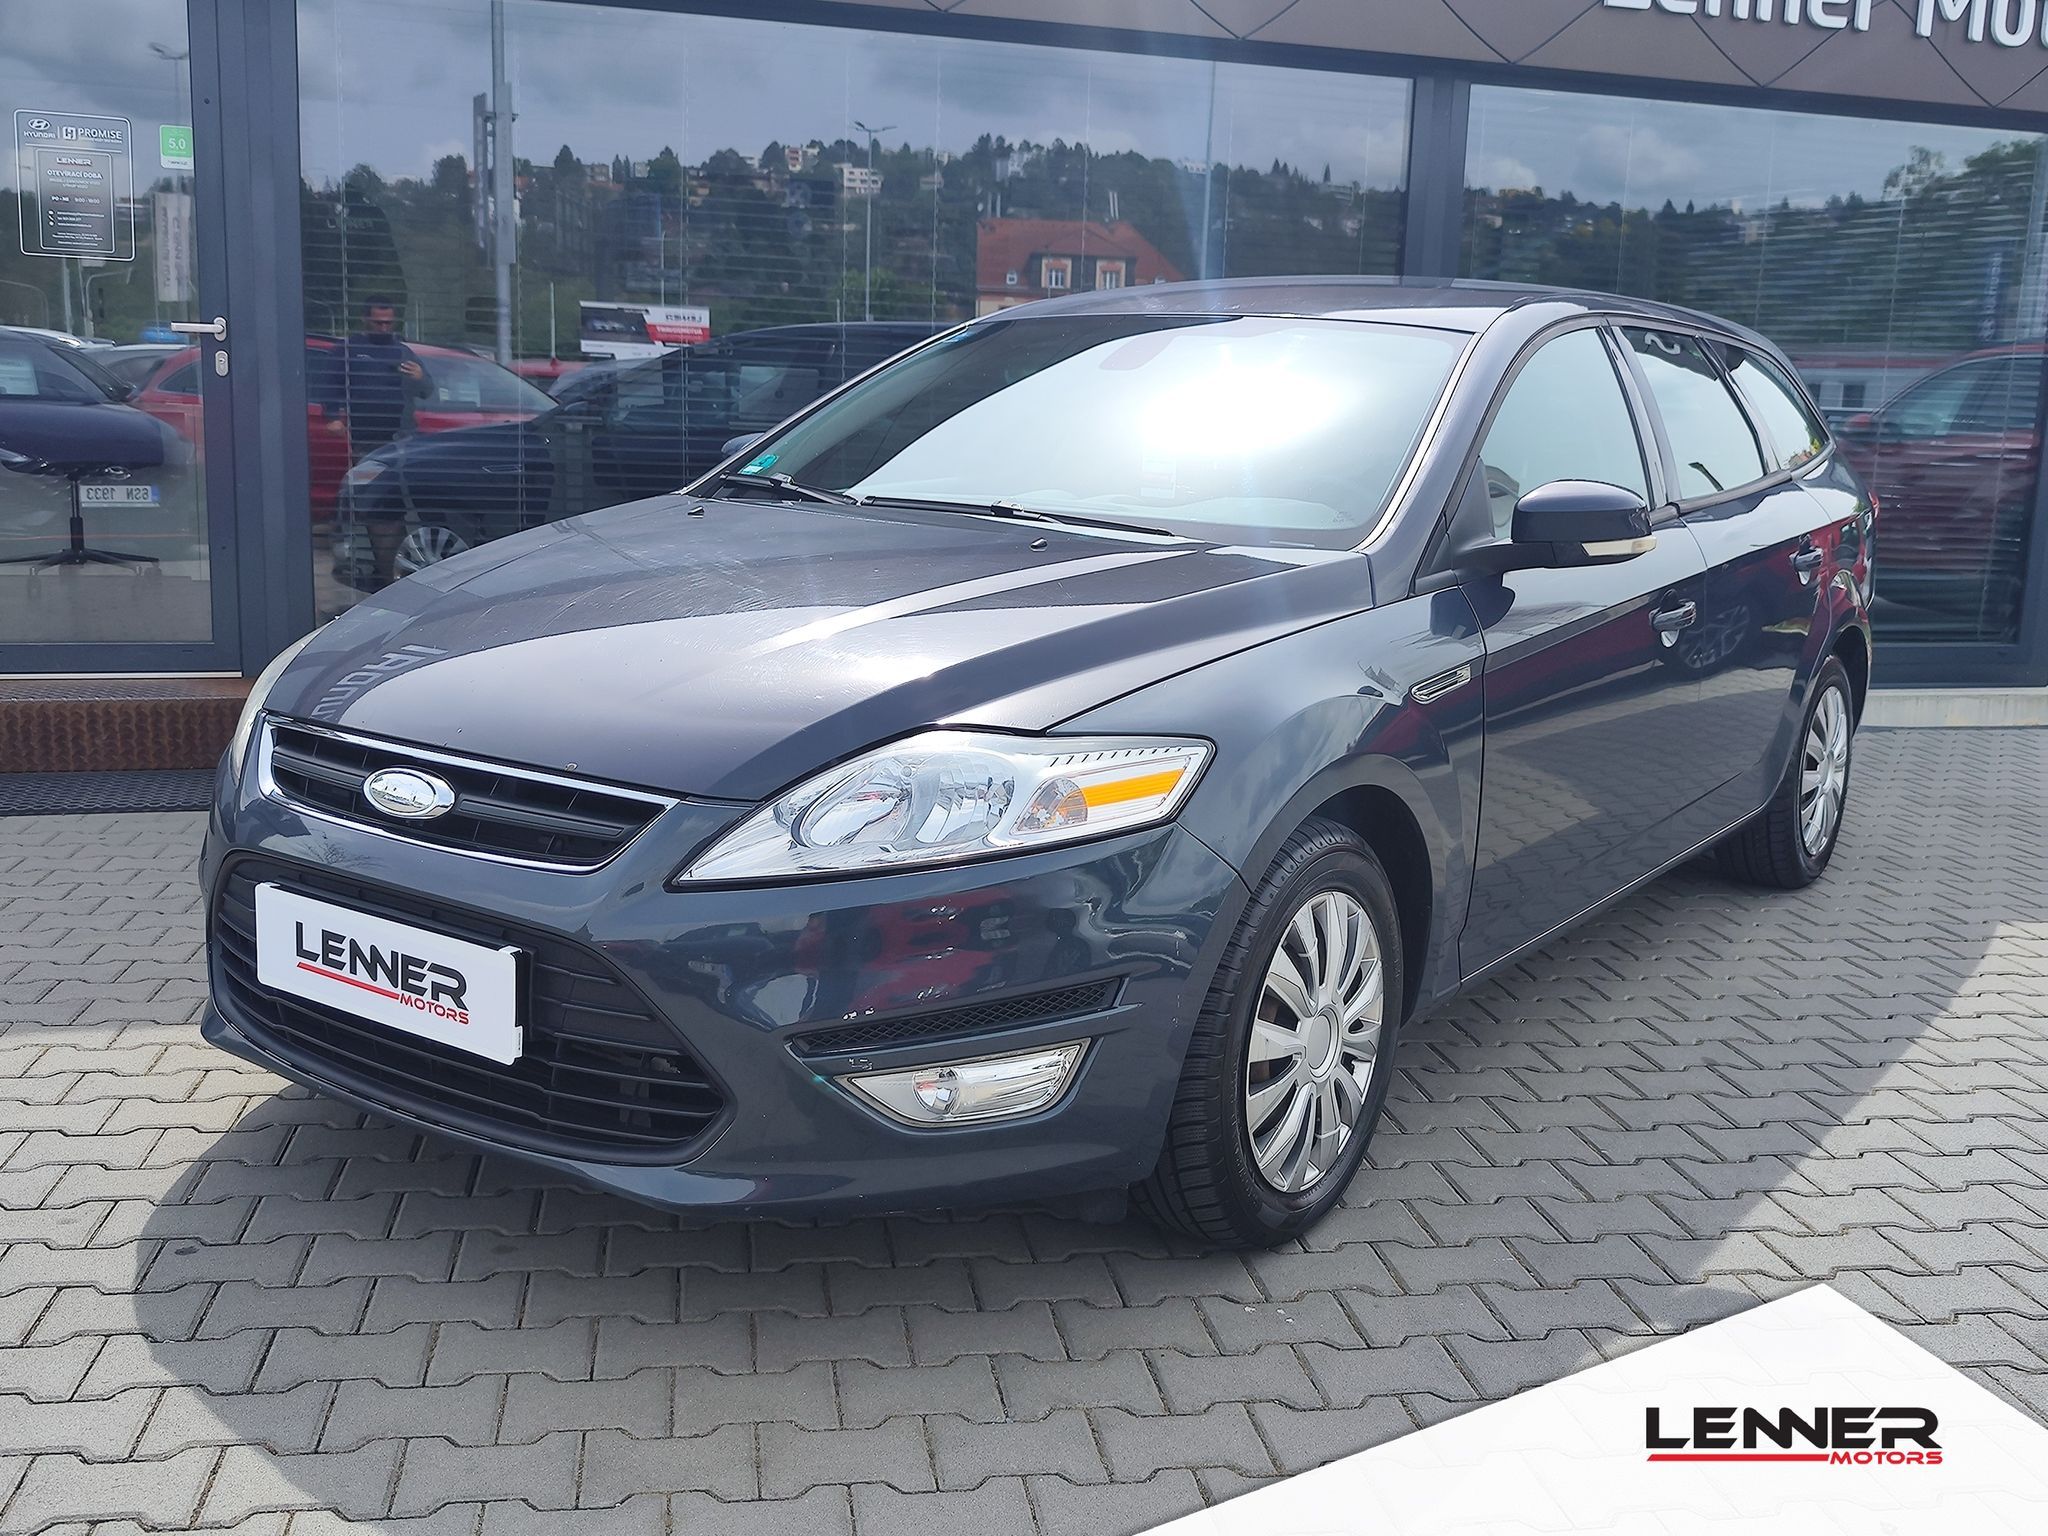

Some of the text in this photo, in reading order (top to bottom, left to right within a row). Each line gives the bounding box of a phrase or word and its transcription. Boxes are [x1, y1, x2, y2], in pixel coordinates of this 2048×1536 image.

[1915, 0, 2048, 47] Mo
[23, 128, 123, 140] HYUNDAI PROMISE
[56, 156, 92, 166] LENNER
[295, 920, 470, 1012] LENNER
[399, 992, 470, 1026] MOTORS
